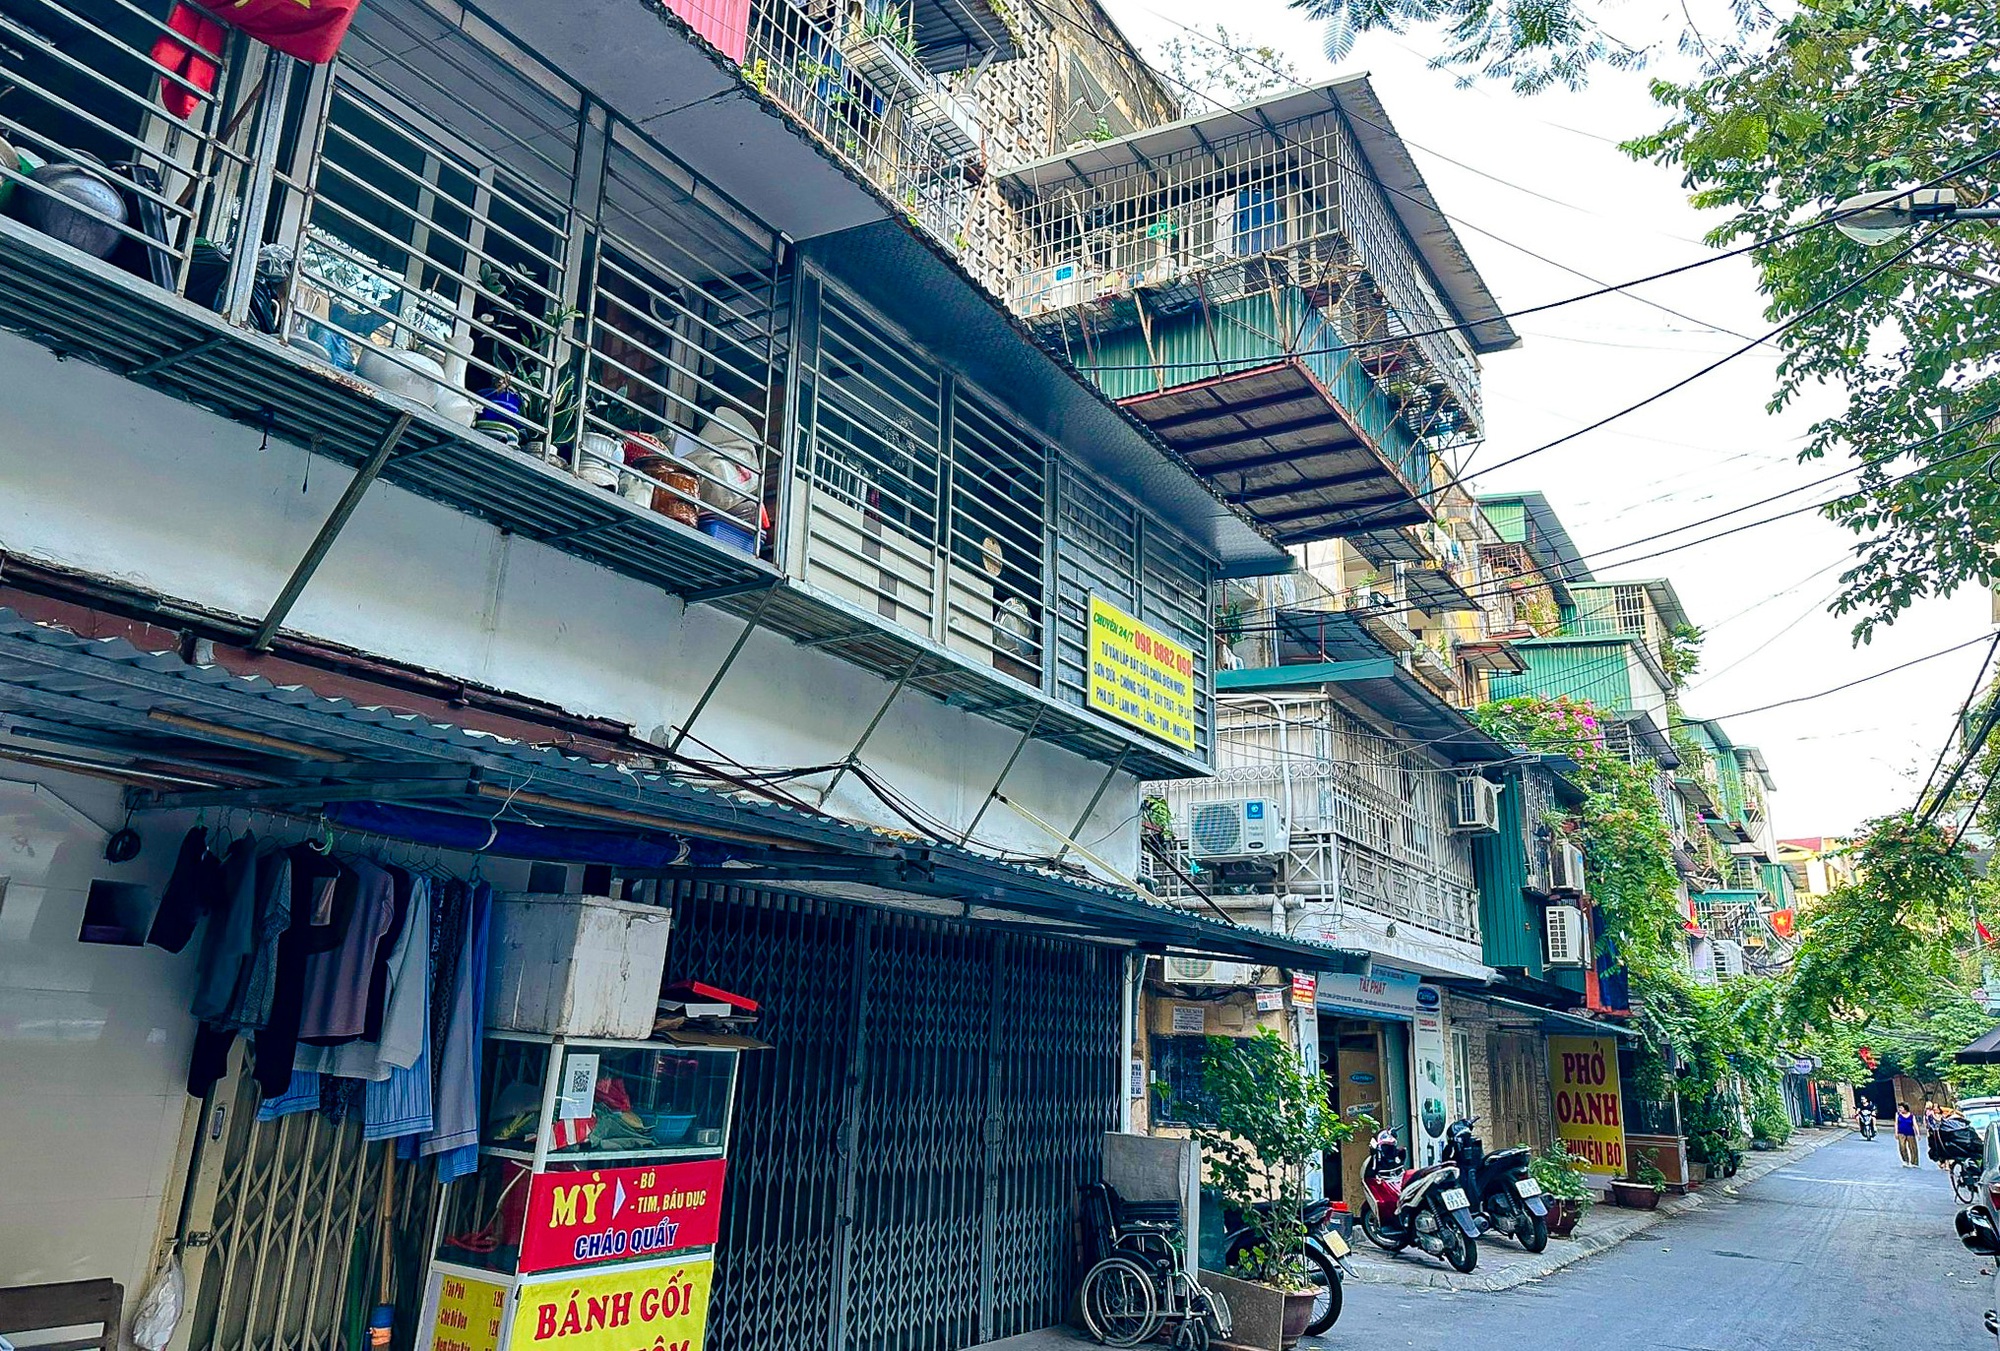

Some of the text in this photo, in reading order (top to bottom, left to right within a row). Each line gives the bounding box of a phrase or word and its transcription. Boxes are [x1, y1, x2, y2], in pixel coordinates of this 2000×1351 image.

[1094, 612, 1191, 678] CHUYÊN 24/7 098 8882 098
[1562, 1040, 1606, 1086] PHỞ
[1556, 1091, 1619, 1126] OANH
[1606, 1136, 1622, 1167] BÒ
[640, 1168, 656, 1190] BÒ
[548, 1171, 607, 1228] MỲ
[638, 1195, 660, 1214] TIM,
[662, 1188, 684, 1210] BẦU
[686, 1190, 707, 1211] DỤC
[574, 1216, 679, 1260] CHÁO QUẨY
[493, 1290, 505, 1307] 12K
[534, 1270, 693, 1340] BÁNH GỐI
[489, 1319, 500, 1337] 12K
